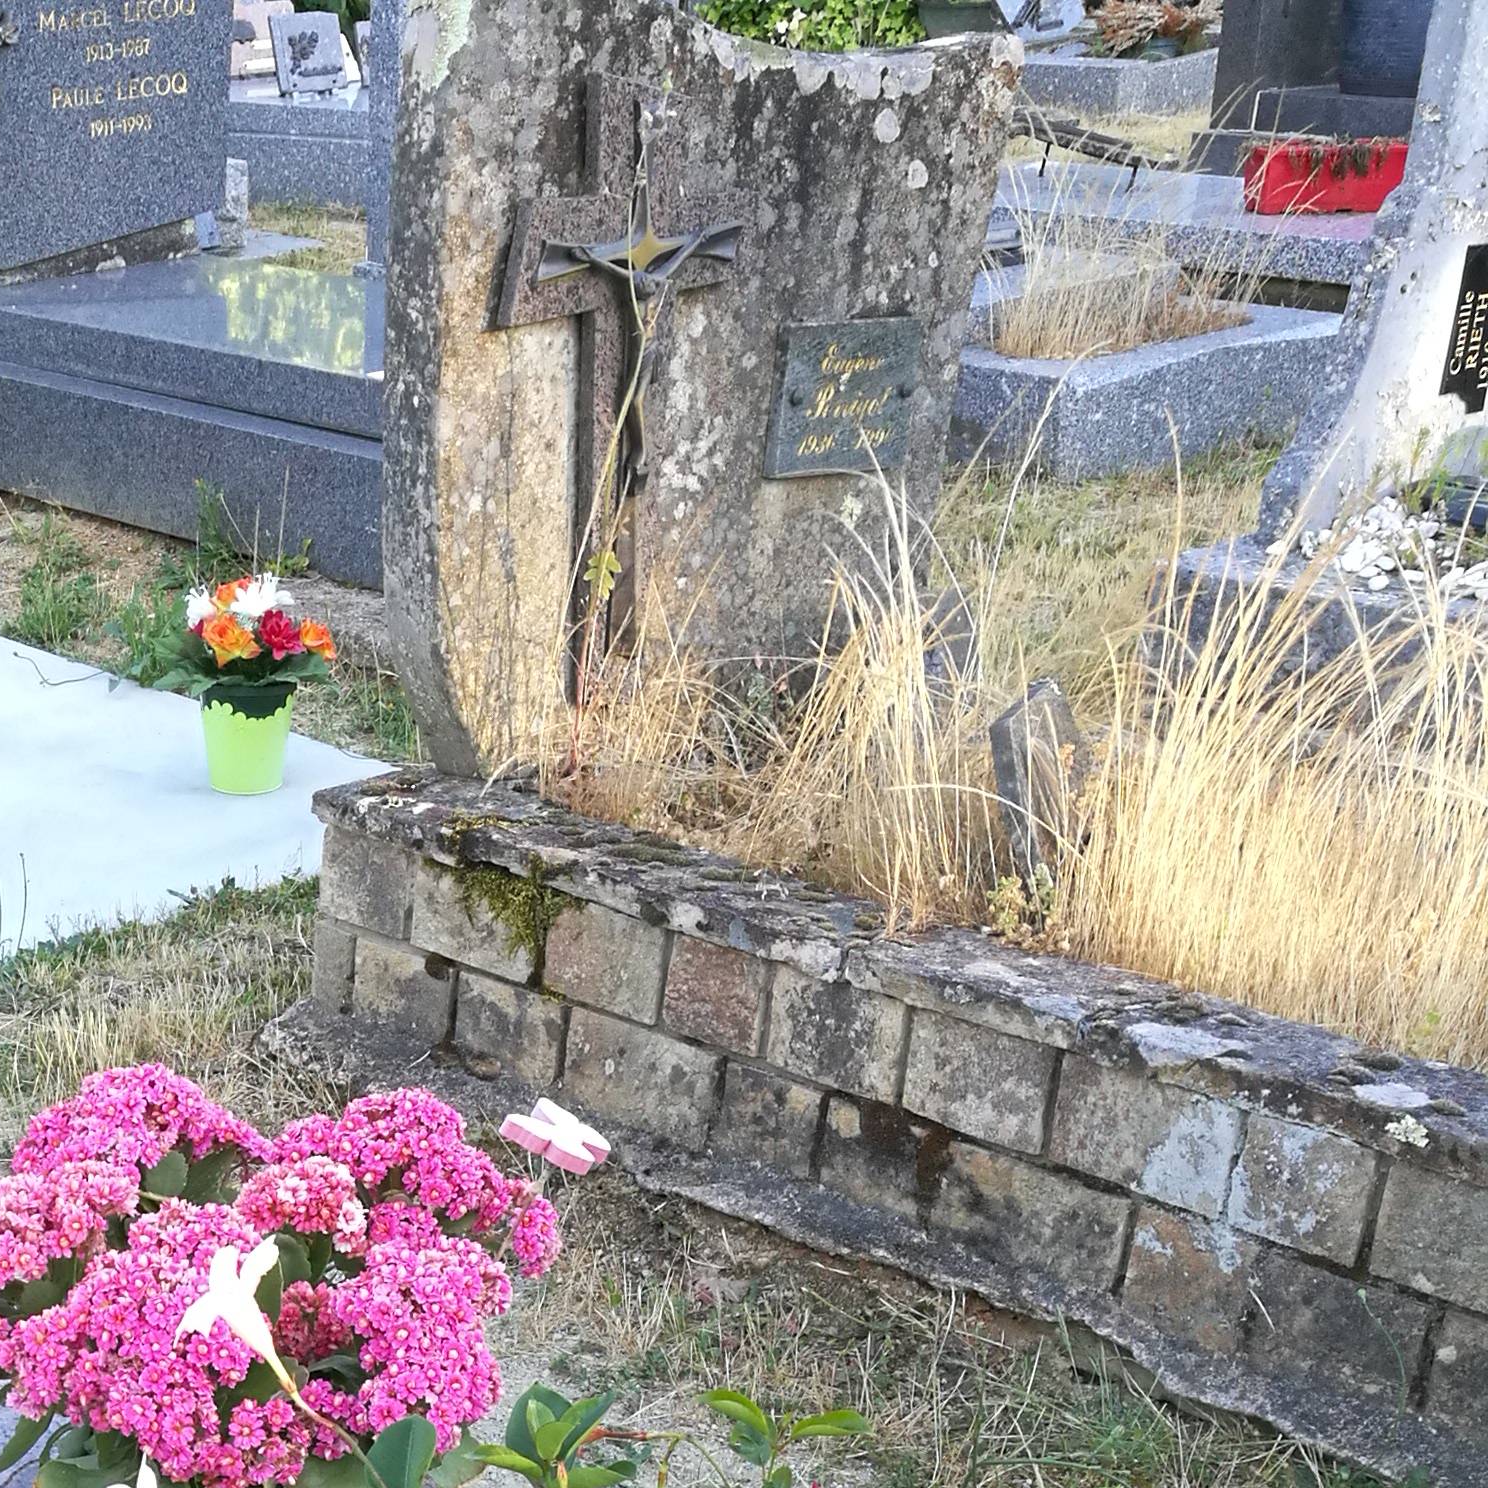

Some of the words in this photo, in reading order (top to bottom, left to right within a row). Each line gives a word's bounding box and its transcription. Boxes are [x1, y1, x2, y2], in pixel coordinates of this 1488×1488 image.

[123, 0, 197, 23] LECOQ
[51, 87, 105, 109] PAULE
[117, 72, 188, 101] LECOQ
[1449, 290, 1475, 375] Camille
[1465, 293, 1488, 370] RIETH
